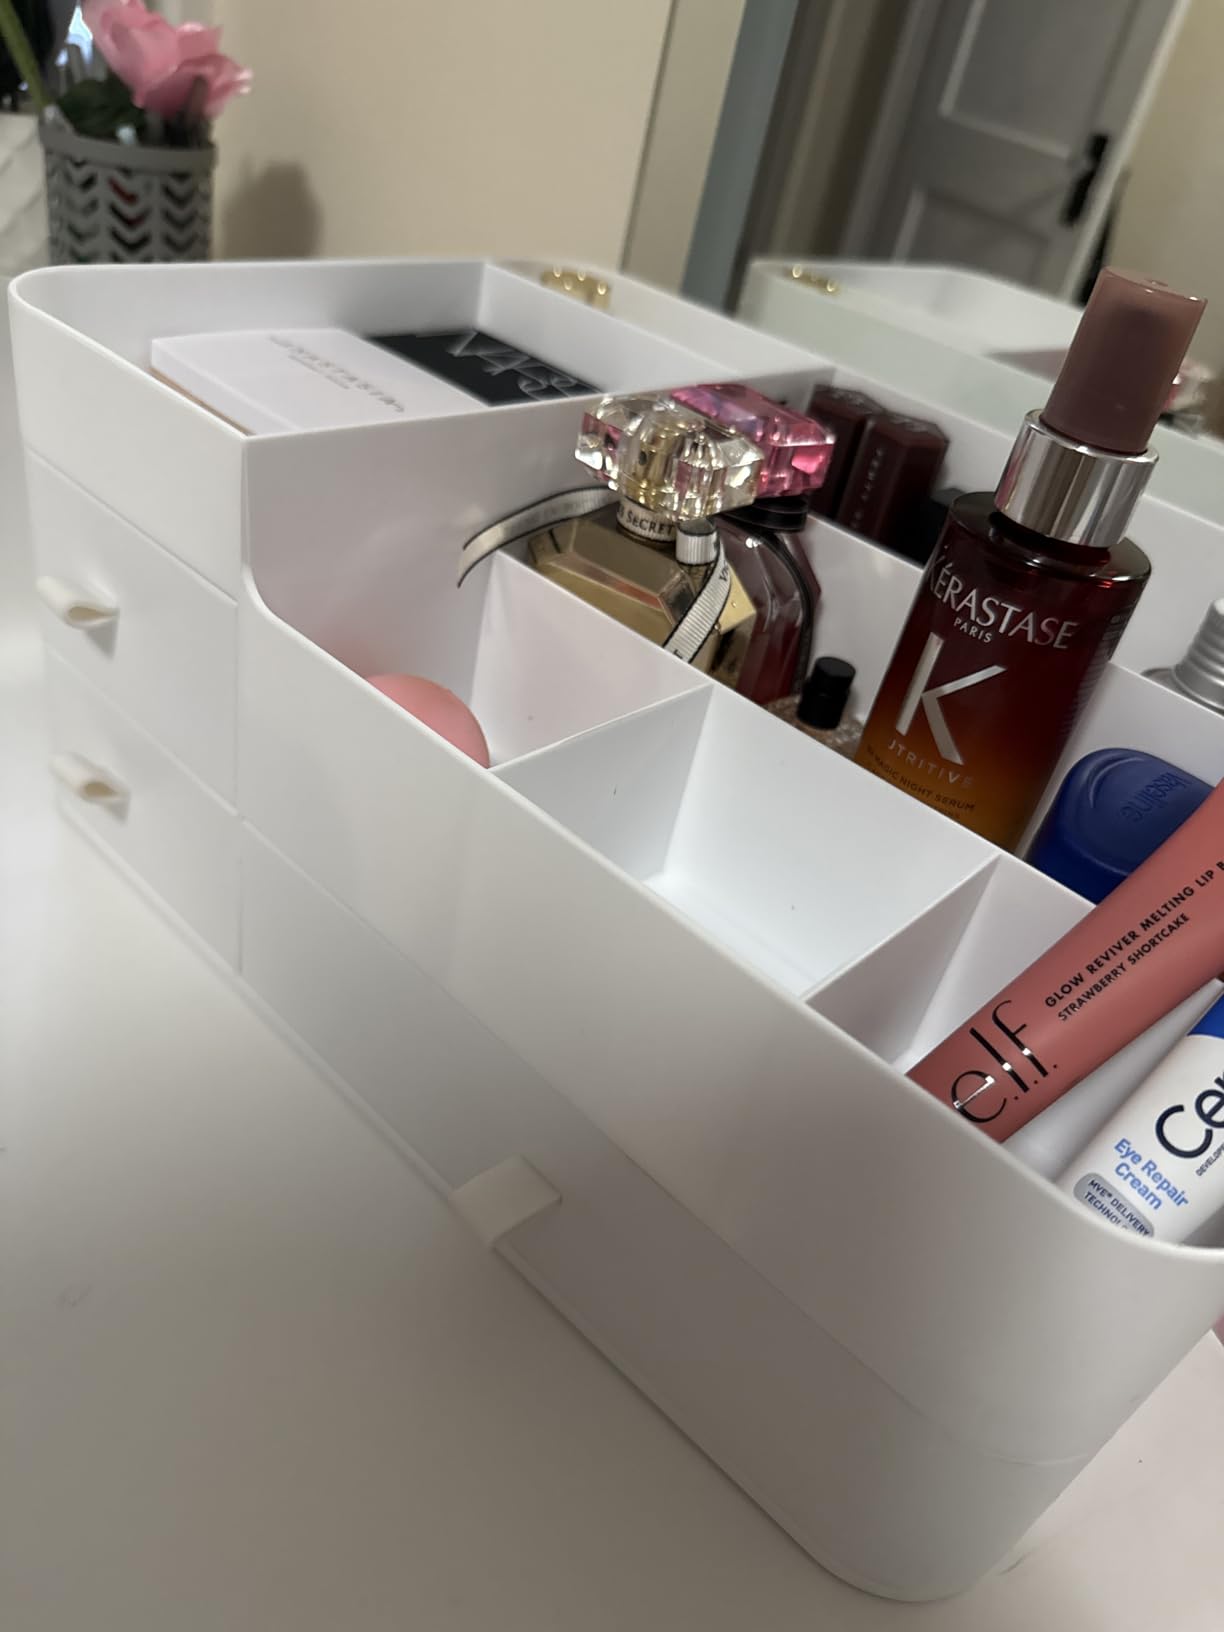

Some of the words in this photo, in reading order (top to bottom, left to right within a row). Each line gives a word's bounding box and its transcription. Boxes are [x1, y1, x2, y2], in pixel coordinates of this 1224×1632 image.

[953, 616, 993, 644] PARIS
[895, 631, 1007, 766] K
[900, 775, 933, 798] NIGHT
[935, 793, 976, 811] SERUM
[1044, 972, 1085, 1008] GLOW
[1086, 930, 1140, 975] REVIVER
[1140, 886, 1195, 932] MELTING
[1195, 869, 1215, 888] LIP
[1058, 962, 1127, 1022] STRAWBERRY
[1127, 913, 1190, 966] SHORTCAKE
[1114, 1138, 1142, 1165] Eye
[1141, 1159, 1189, 1208] Repair
[1114, 1162, 1163, 1211] Cream
[1110, 1198, 1150, 1237] DELIVERY
